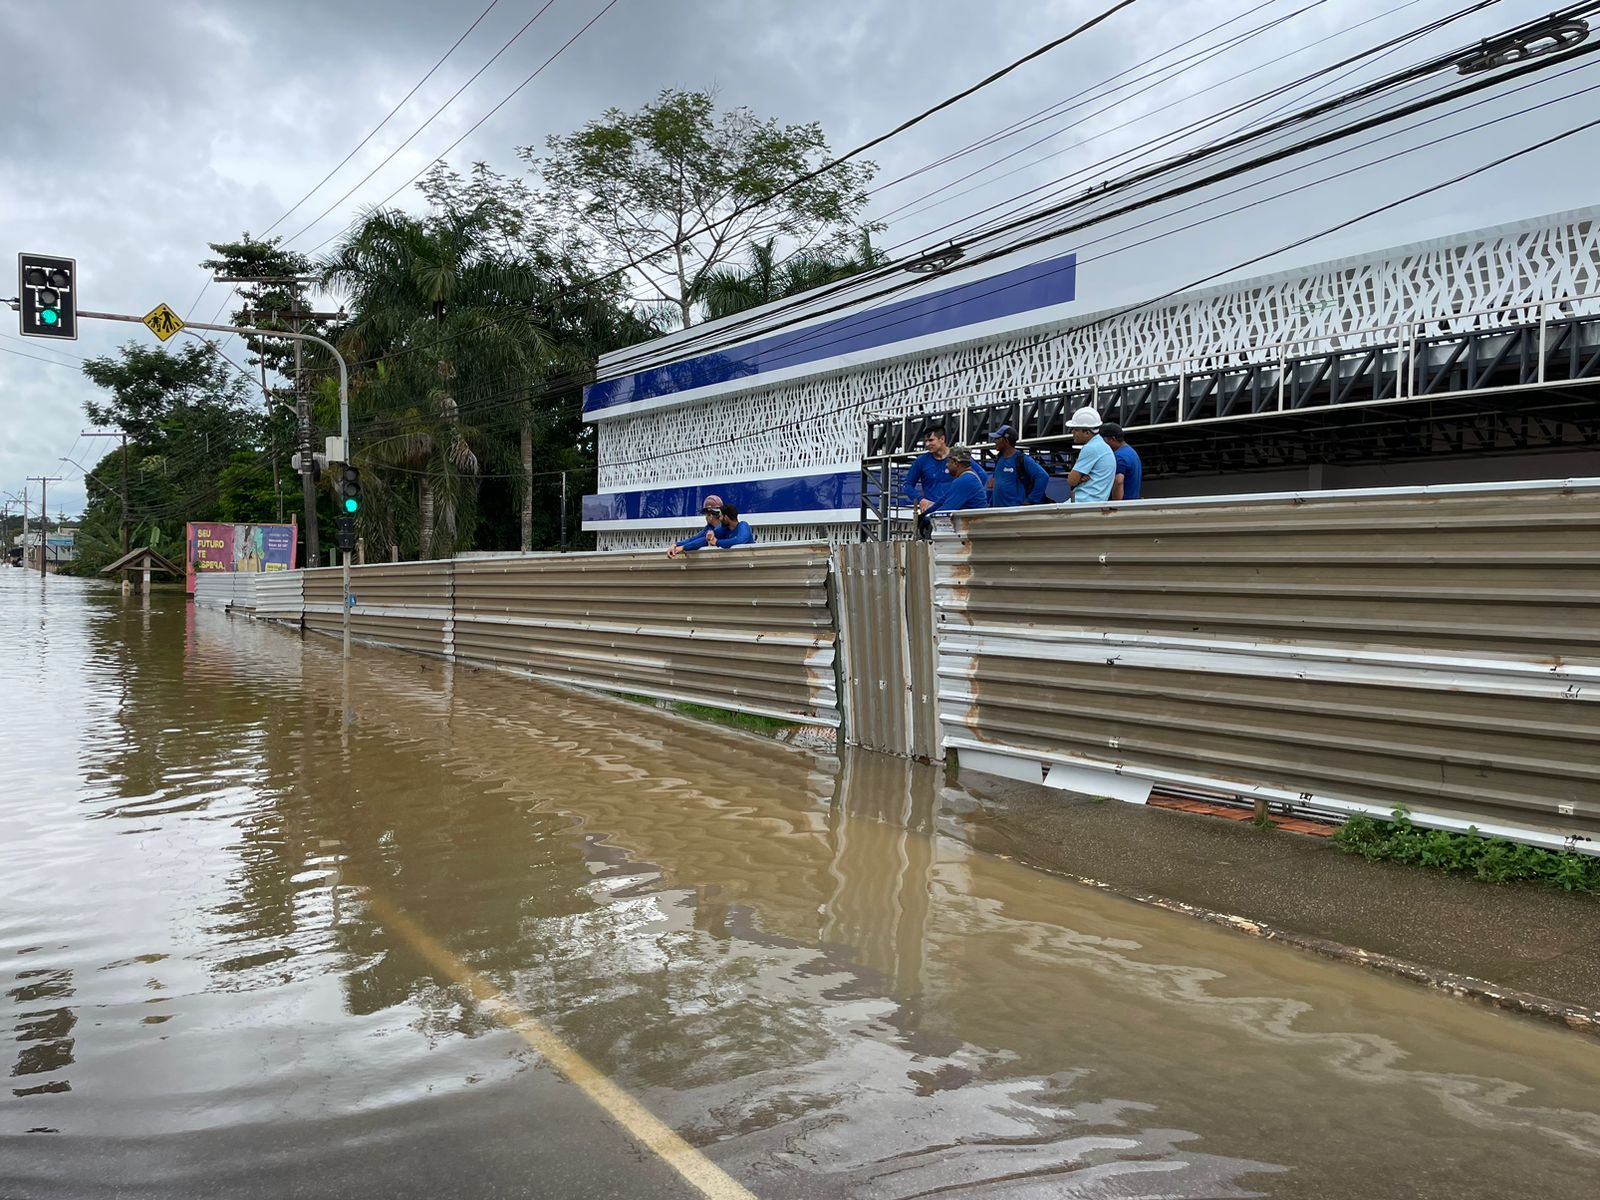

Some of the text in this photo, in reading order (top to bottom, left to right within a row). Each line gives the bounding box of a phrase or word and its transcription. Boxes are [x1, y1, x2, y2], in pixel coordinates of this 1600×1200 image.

[197, 529, 211, 538] SEU
[197, 539, 225, 549] FUTURO
[197, 550, 207, 559] TE
